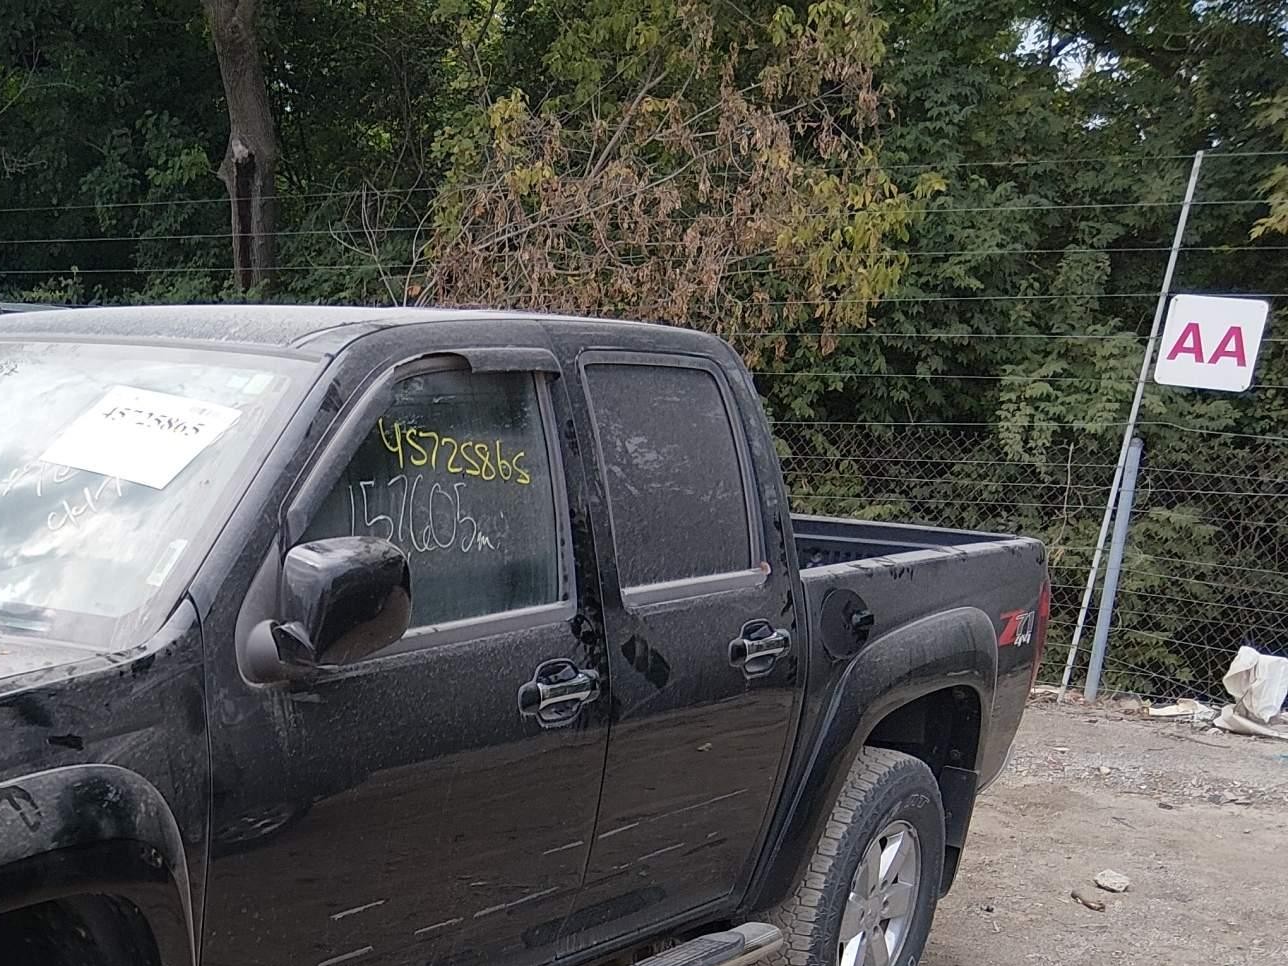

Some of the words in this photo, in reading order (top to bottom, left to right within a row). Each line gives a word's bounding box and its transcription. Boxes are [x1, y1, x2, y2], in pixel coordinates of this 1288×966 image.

[1166, 322, 1247, 367] AA
[378, 417, 530, 485] 45725865
[999, 609, 1035, 647] Z71
